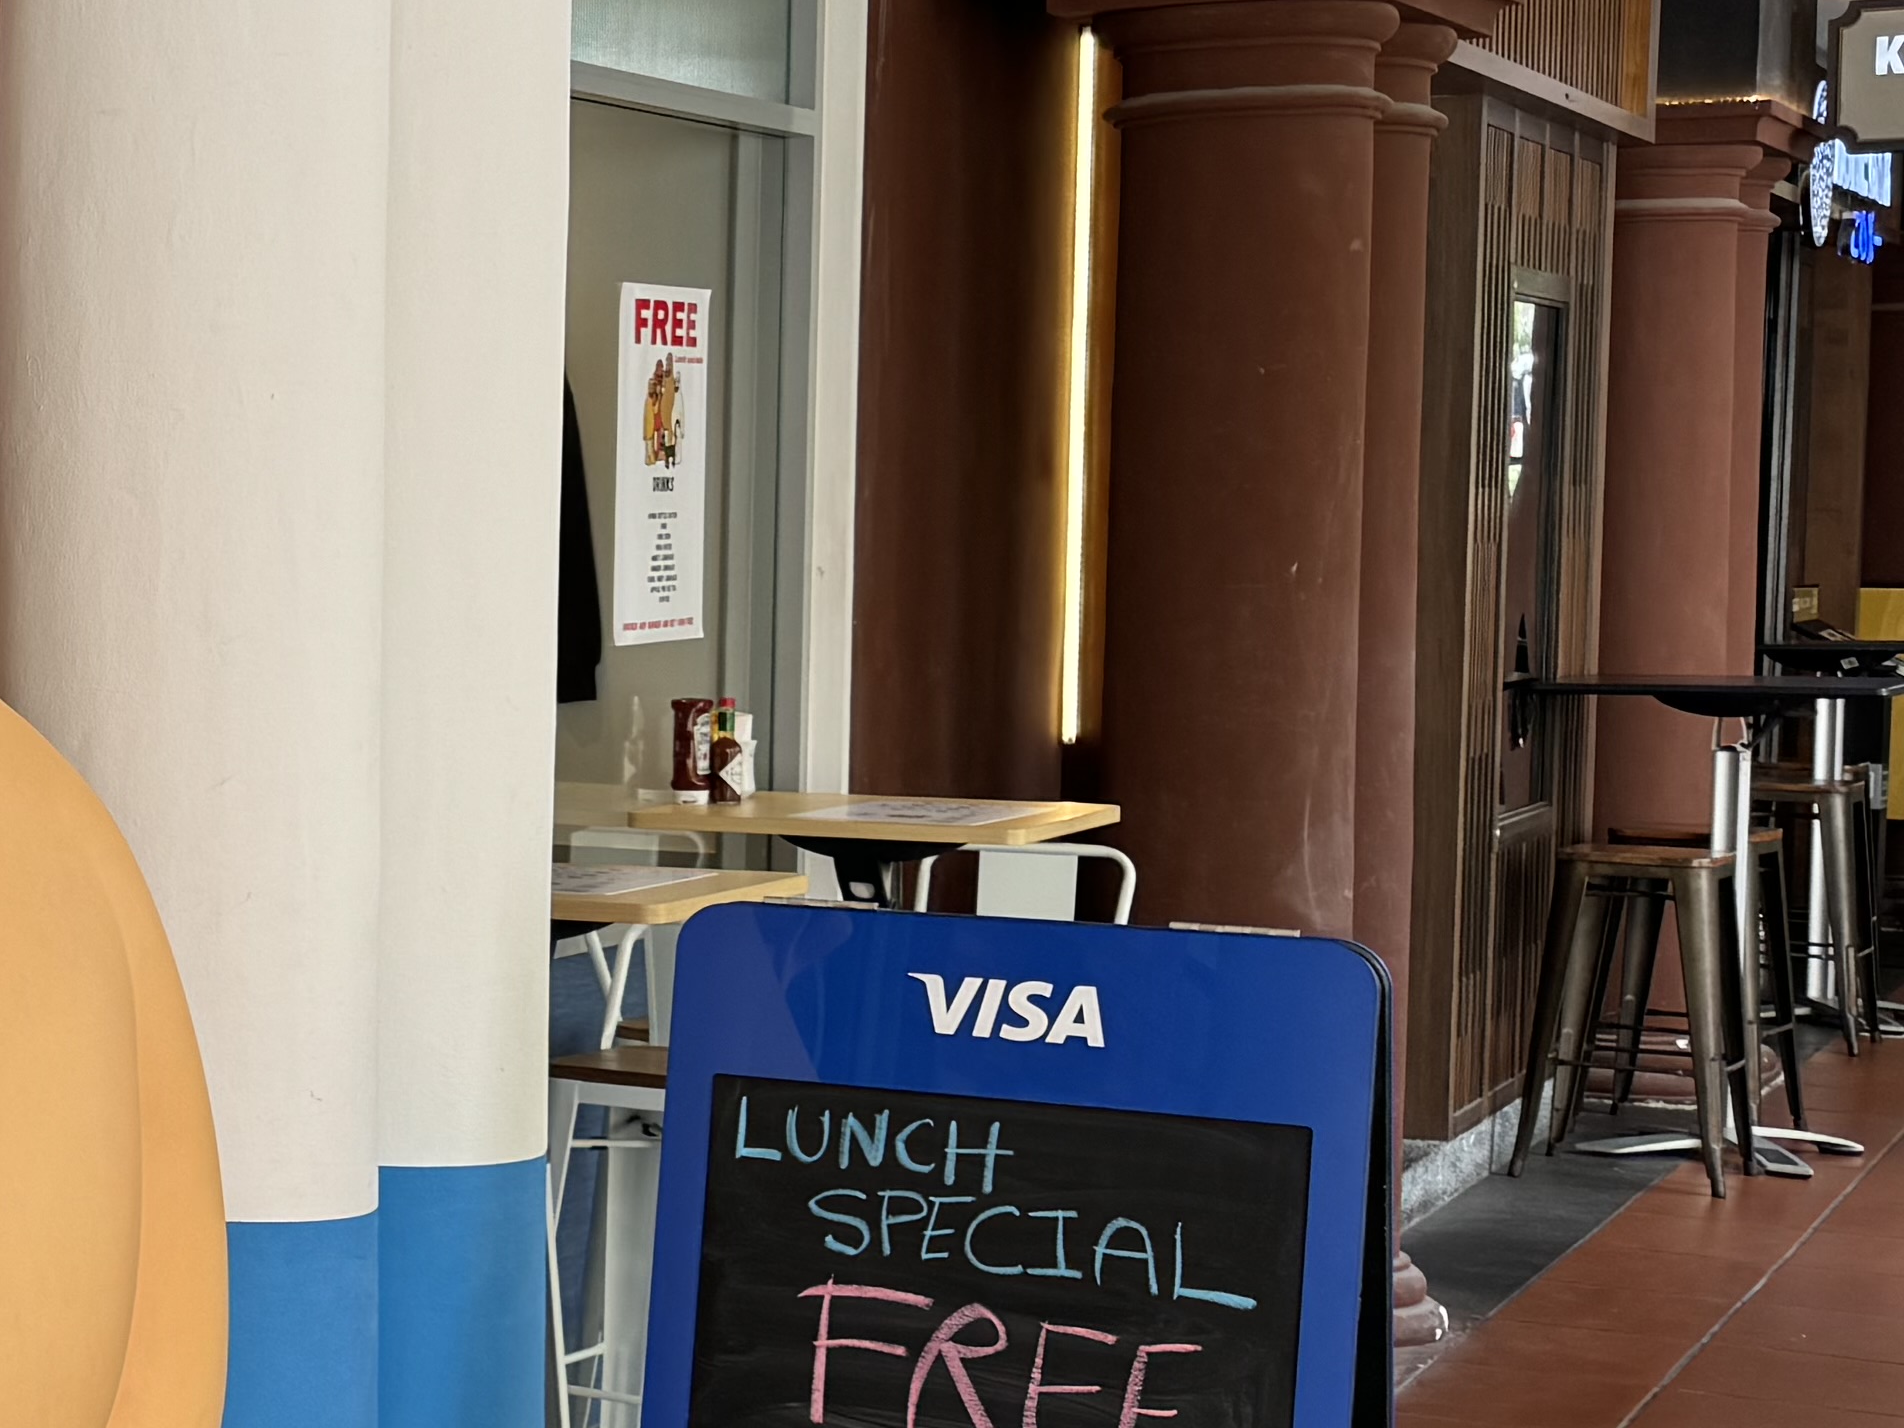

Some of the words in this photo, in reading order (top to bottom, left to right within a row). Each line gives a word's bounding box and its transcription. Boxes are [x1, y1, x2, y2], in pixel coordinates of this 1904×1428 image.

[634, 298, 698, 348] FREE
[908, 972, 1105, 1048] VISA
[735, 1096, 1014, 1193] LUNCH
[808, 1189, 1257, 1310] SPECIAL
